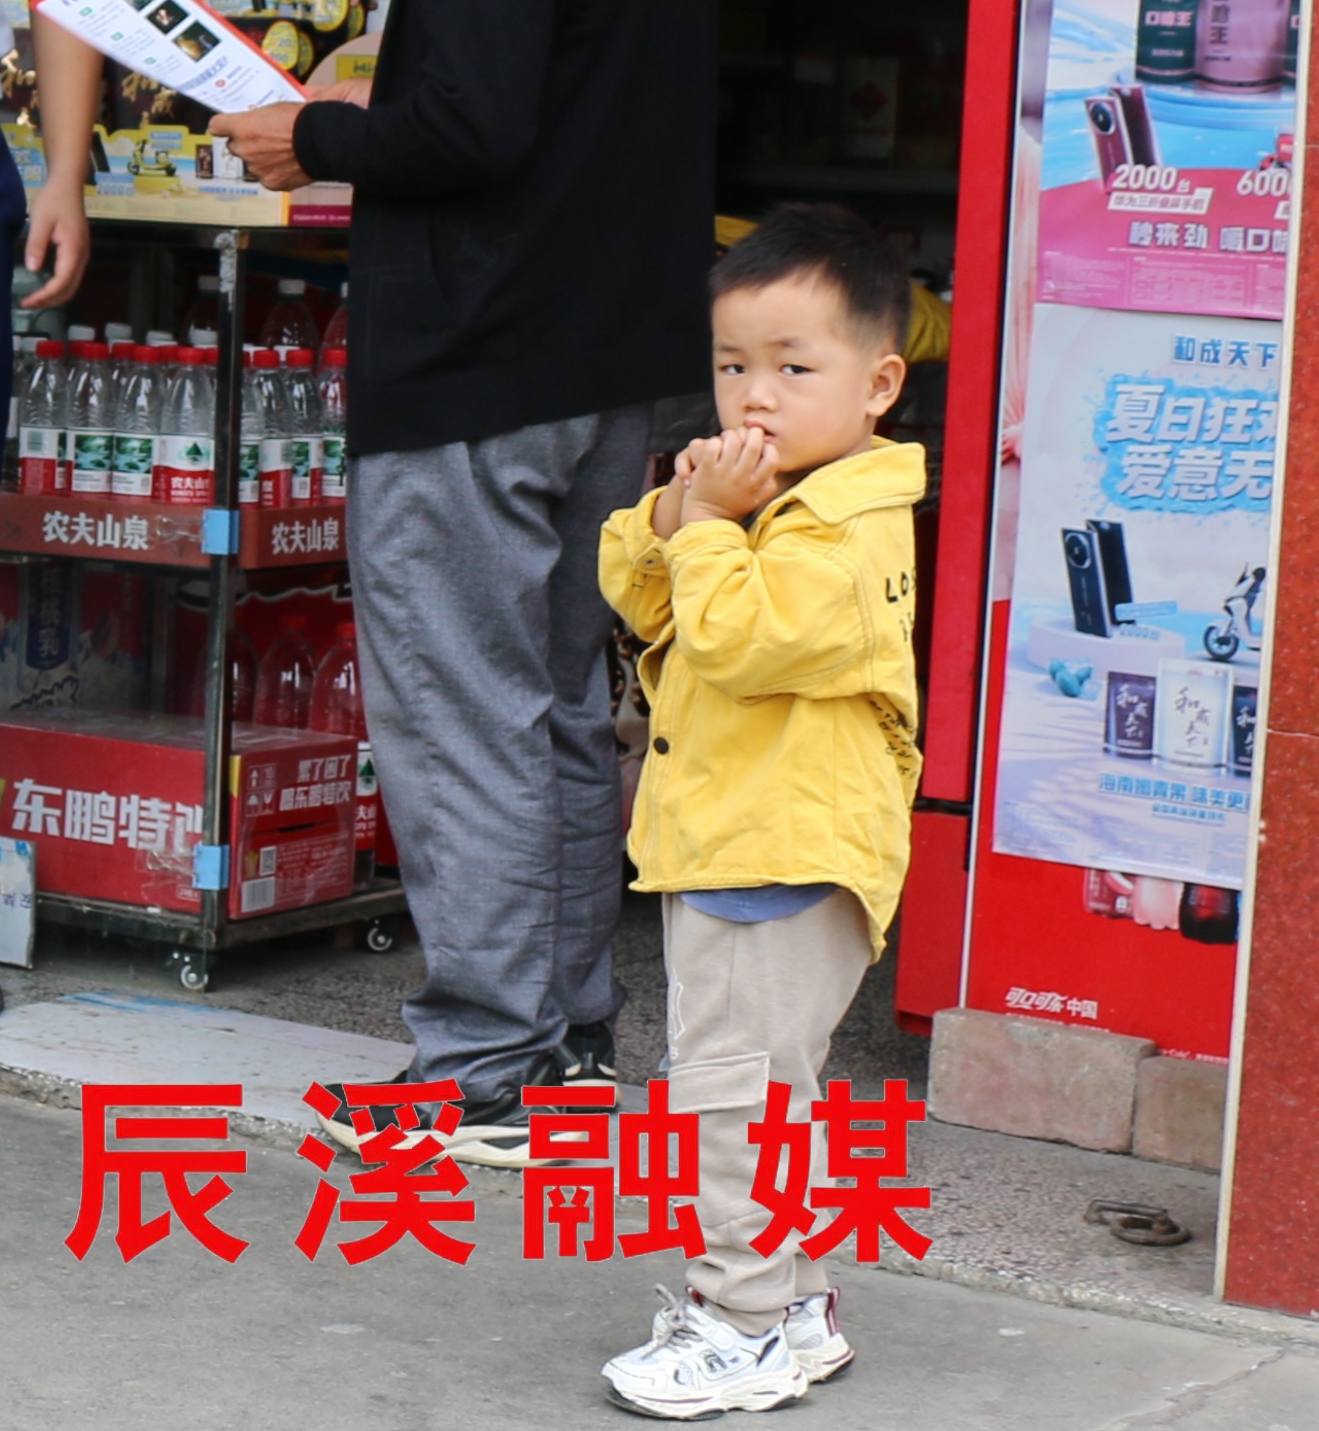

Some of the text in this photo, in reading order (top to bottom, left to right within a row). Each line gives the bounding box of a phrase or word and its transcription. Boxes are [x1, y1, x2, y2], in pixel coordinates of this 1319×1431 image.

[1112, 164, 1190, 193] 2000台
[1236, 170, 1291, 197] 600
[1113, 194, 1205, 212] 华为三折叠屏手机
[1173, 335, 1279, 368] 和成天下
[1115, 444, 1273, 502] 爱意无
[42, 511, 150, 552] 农夫山泉
[271, 516, 340, 555] 农夫山泉
[279, 781, 352, 811] 喝东鹏特饮
